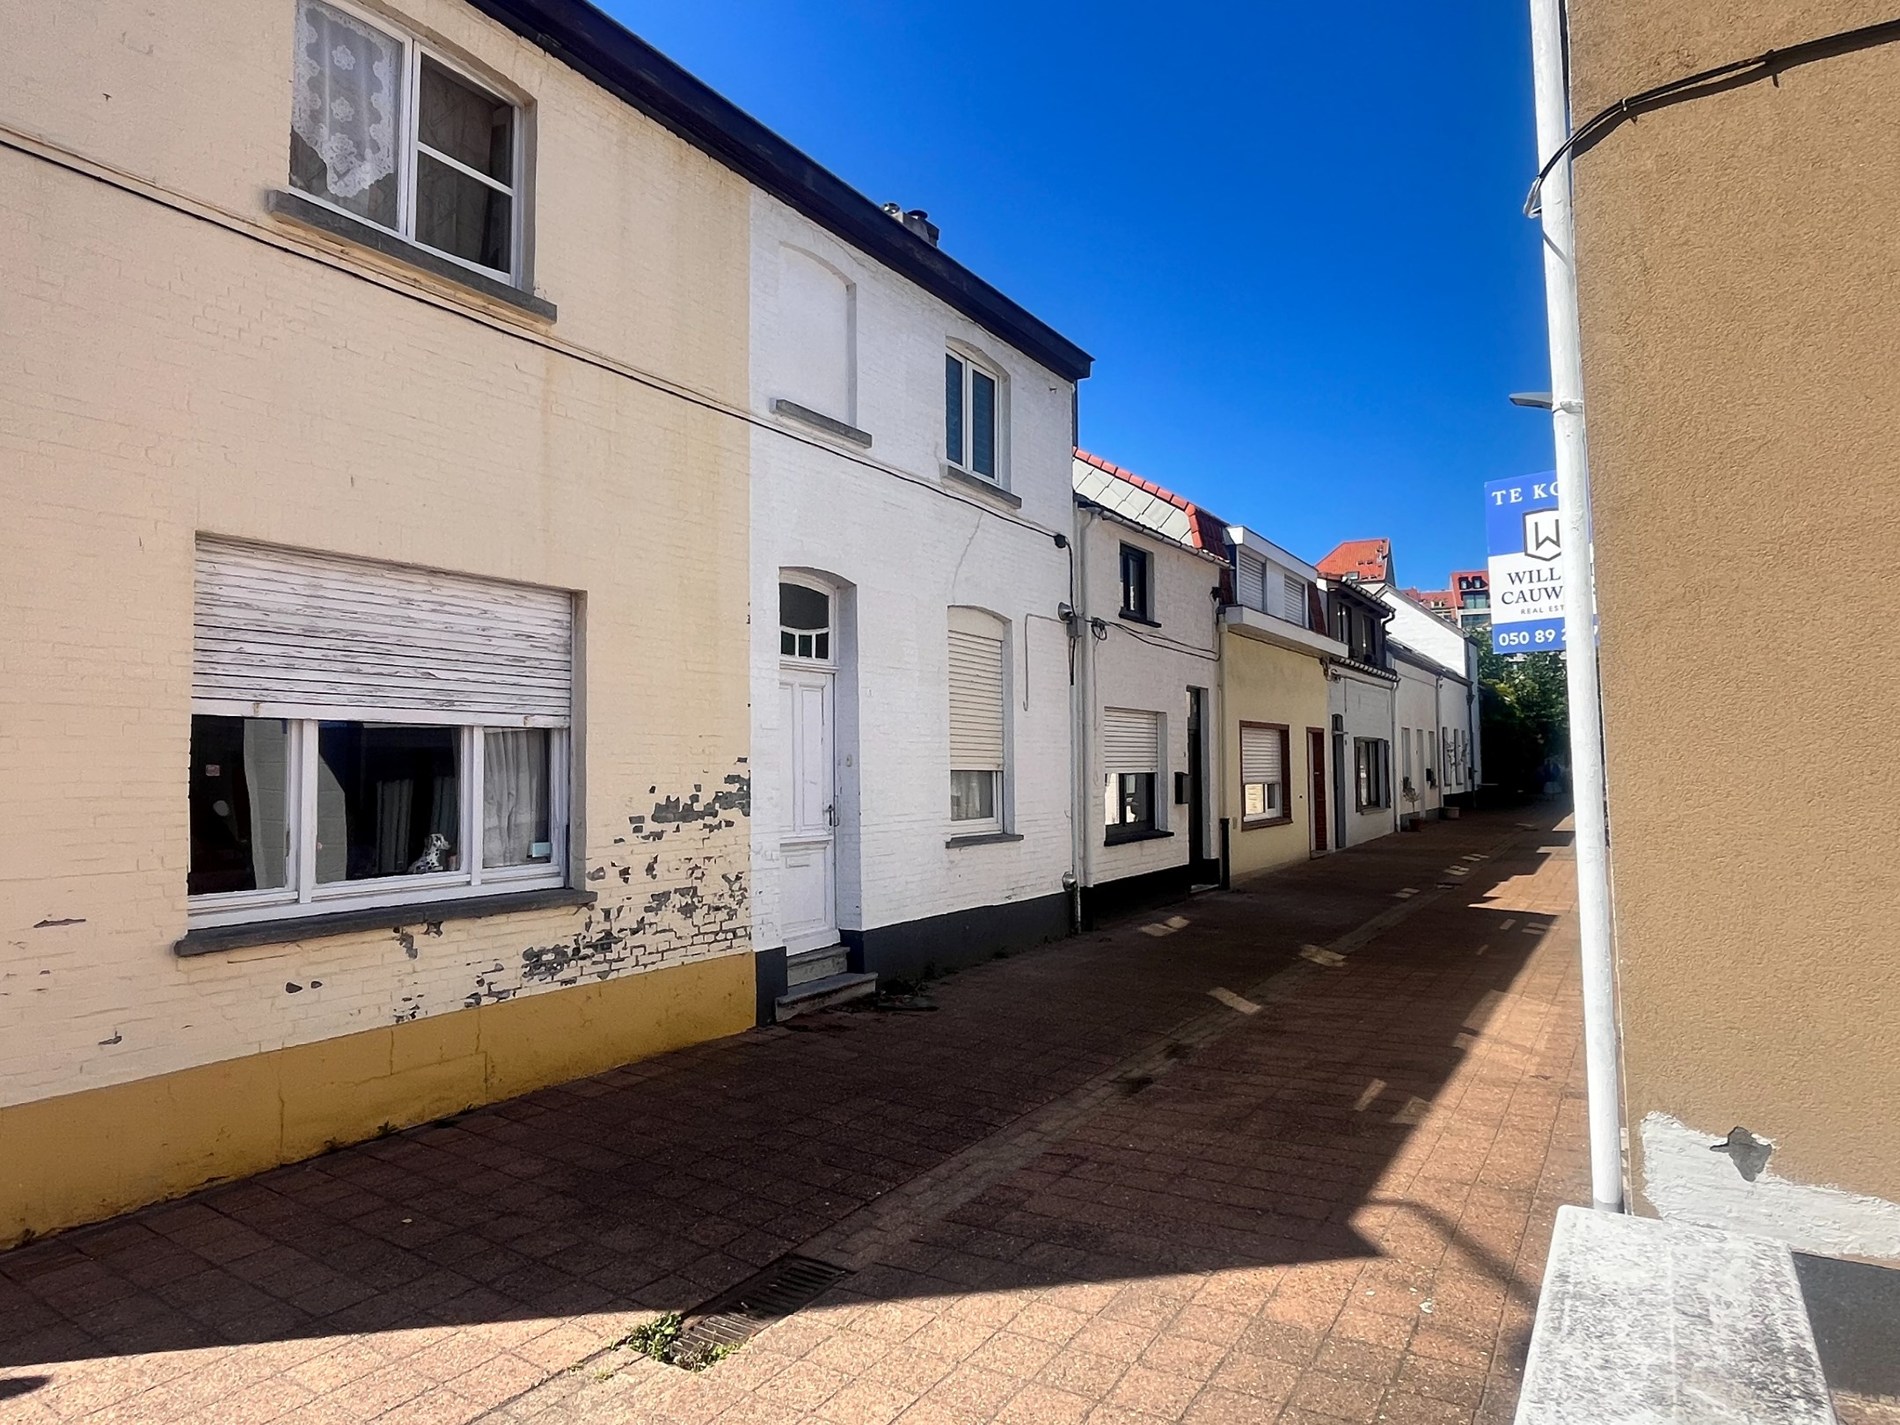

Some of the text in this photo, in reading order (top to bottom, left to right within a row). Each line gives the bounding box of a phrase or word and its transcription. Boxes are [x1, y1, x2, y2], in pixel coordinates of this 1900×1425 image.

[1492, 488, 1523, 505] TE
[1507, 567, 1562, 586] WILL
[1501, 586, 1563, 605] CAUW
[1521, 607, 1544, 615] REAL
[1498, 631, 1530, 646] 050
[1534, 629, 1556, 643] 89
